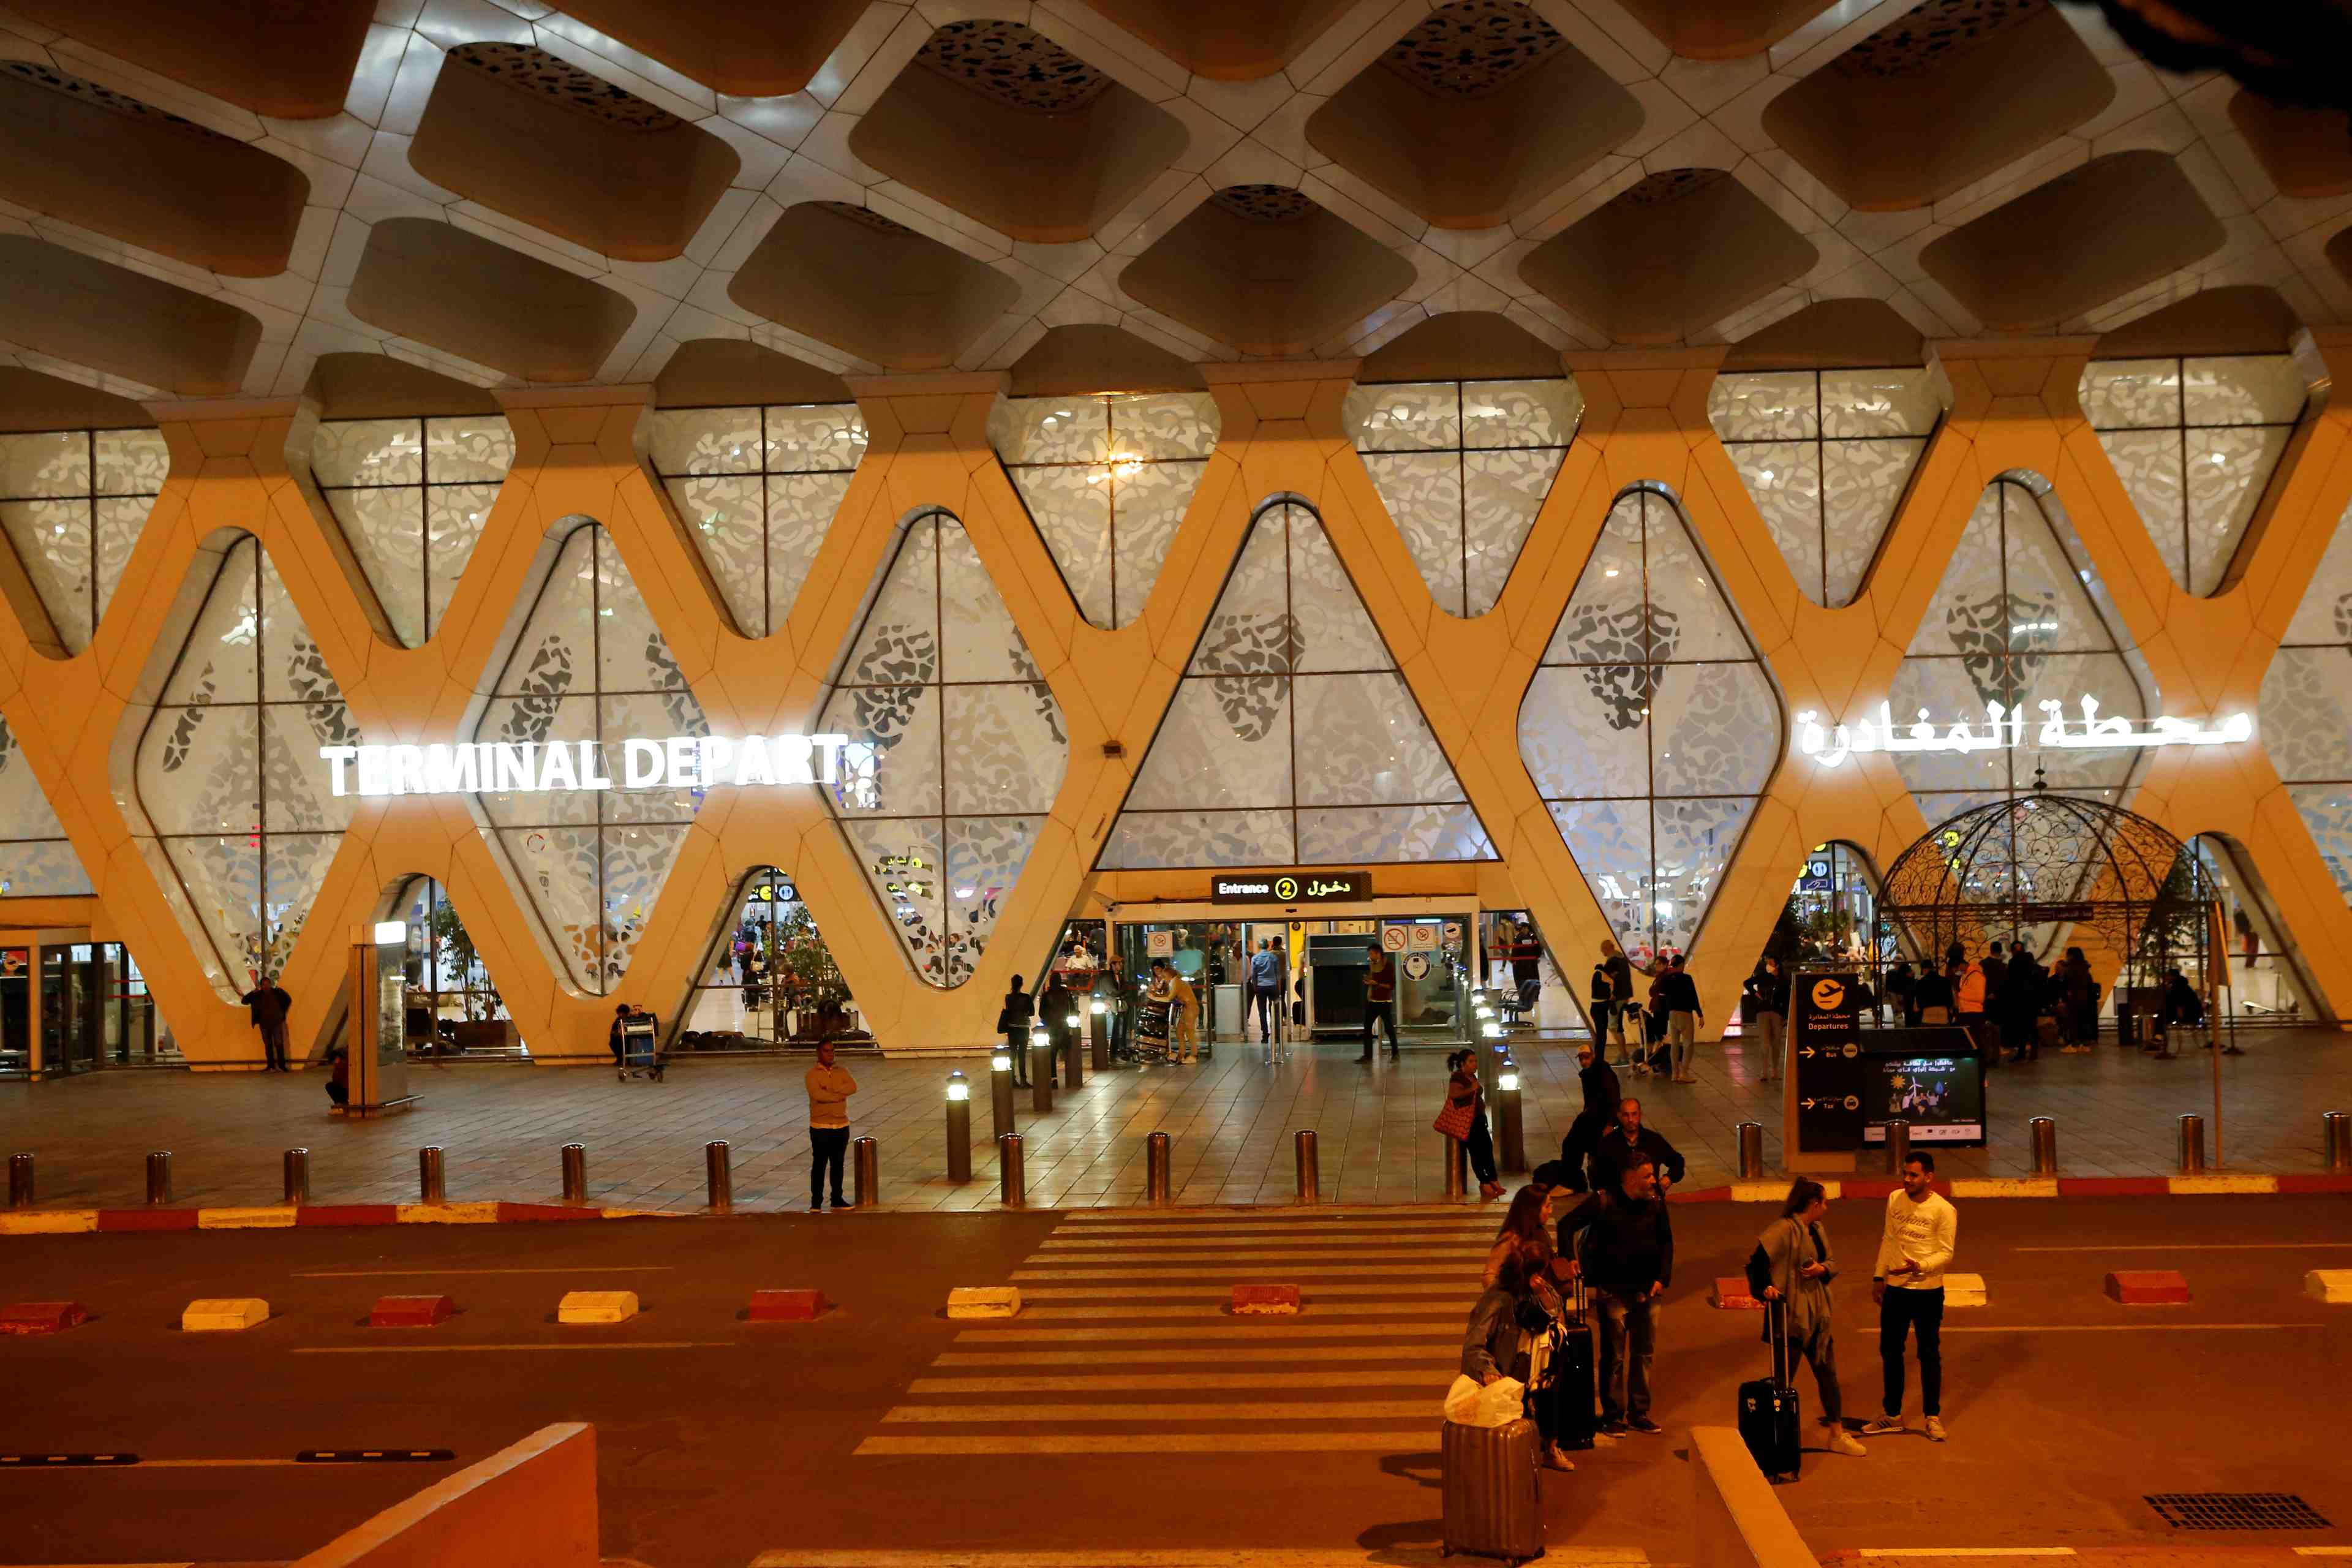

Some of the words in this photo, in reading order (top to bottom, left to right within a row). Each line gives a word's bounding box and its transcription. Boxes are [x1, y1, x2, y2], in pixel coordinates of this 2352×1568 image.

[1797, 699, 2022, 768] المغادرة
[2038, 693, 2252, 748] محطة
[319, 739, 611, 796] TERMINAL
[624, 734, 848, 789] DEPART
[1218, 882, 1270, 895] Entrance
[1281, 881, 1292, 896] 2
[1306, 880, 1351, 897] دخول
[1808, 1023, 1849, 1031] Departures
